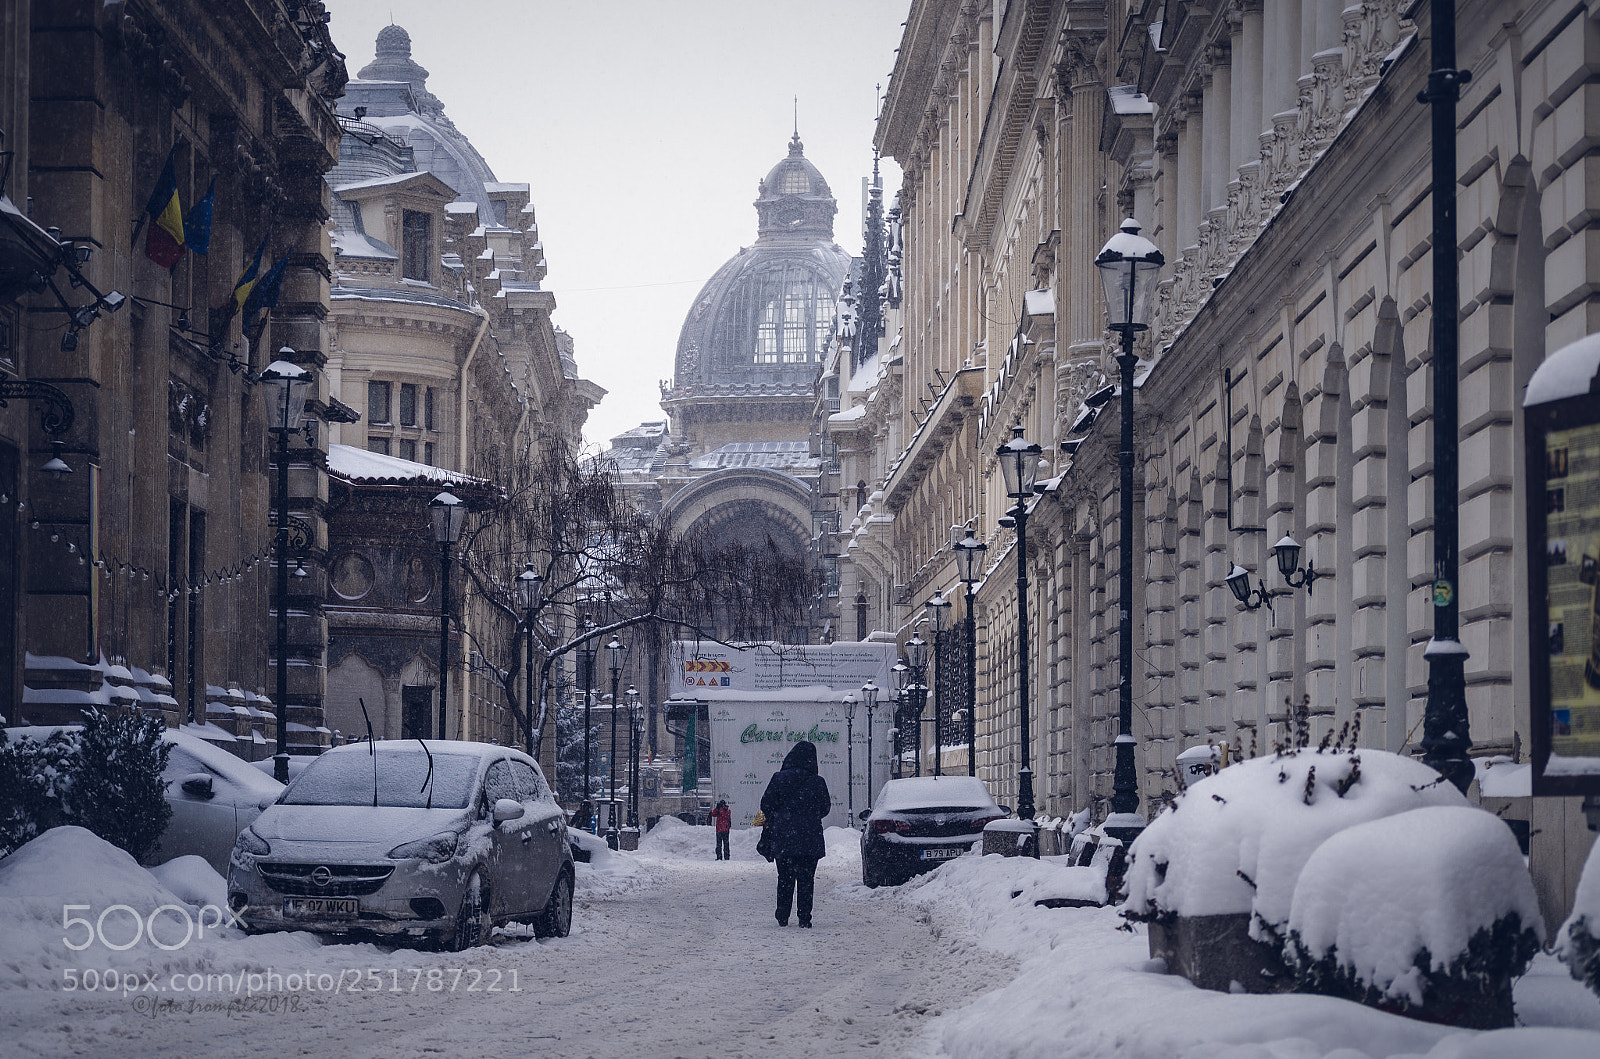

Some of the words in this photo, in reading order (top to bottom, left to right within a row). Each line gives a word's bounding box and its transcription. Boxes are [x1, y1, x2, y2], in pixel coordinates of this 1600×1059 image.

[926, 850, 932, 858] B
[308, 900, 324, 912] 07
[326, 900, 355, 913] WKU
